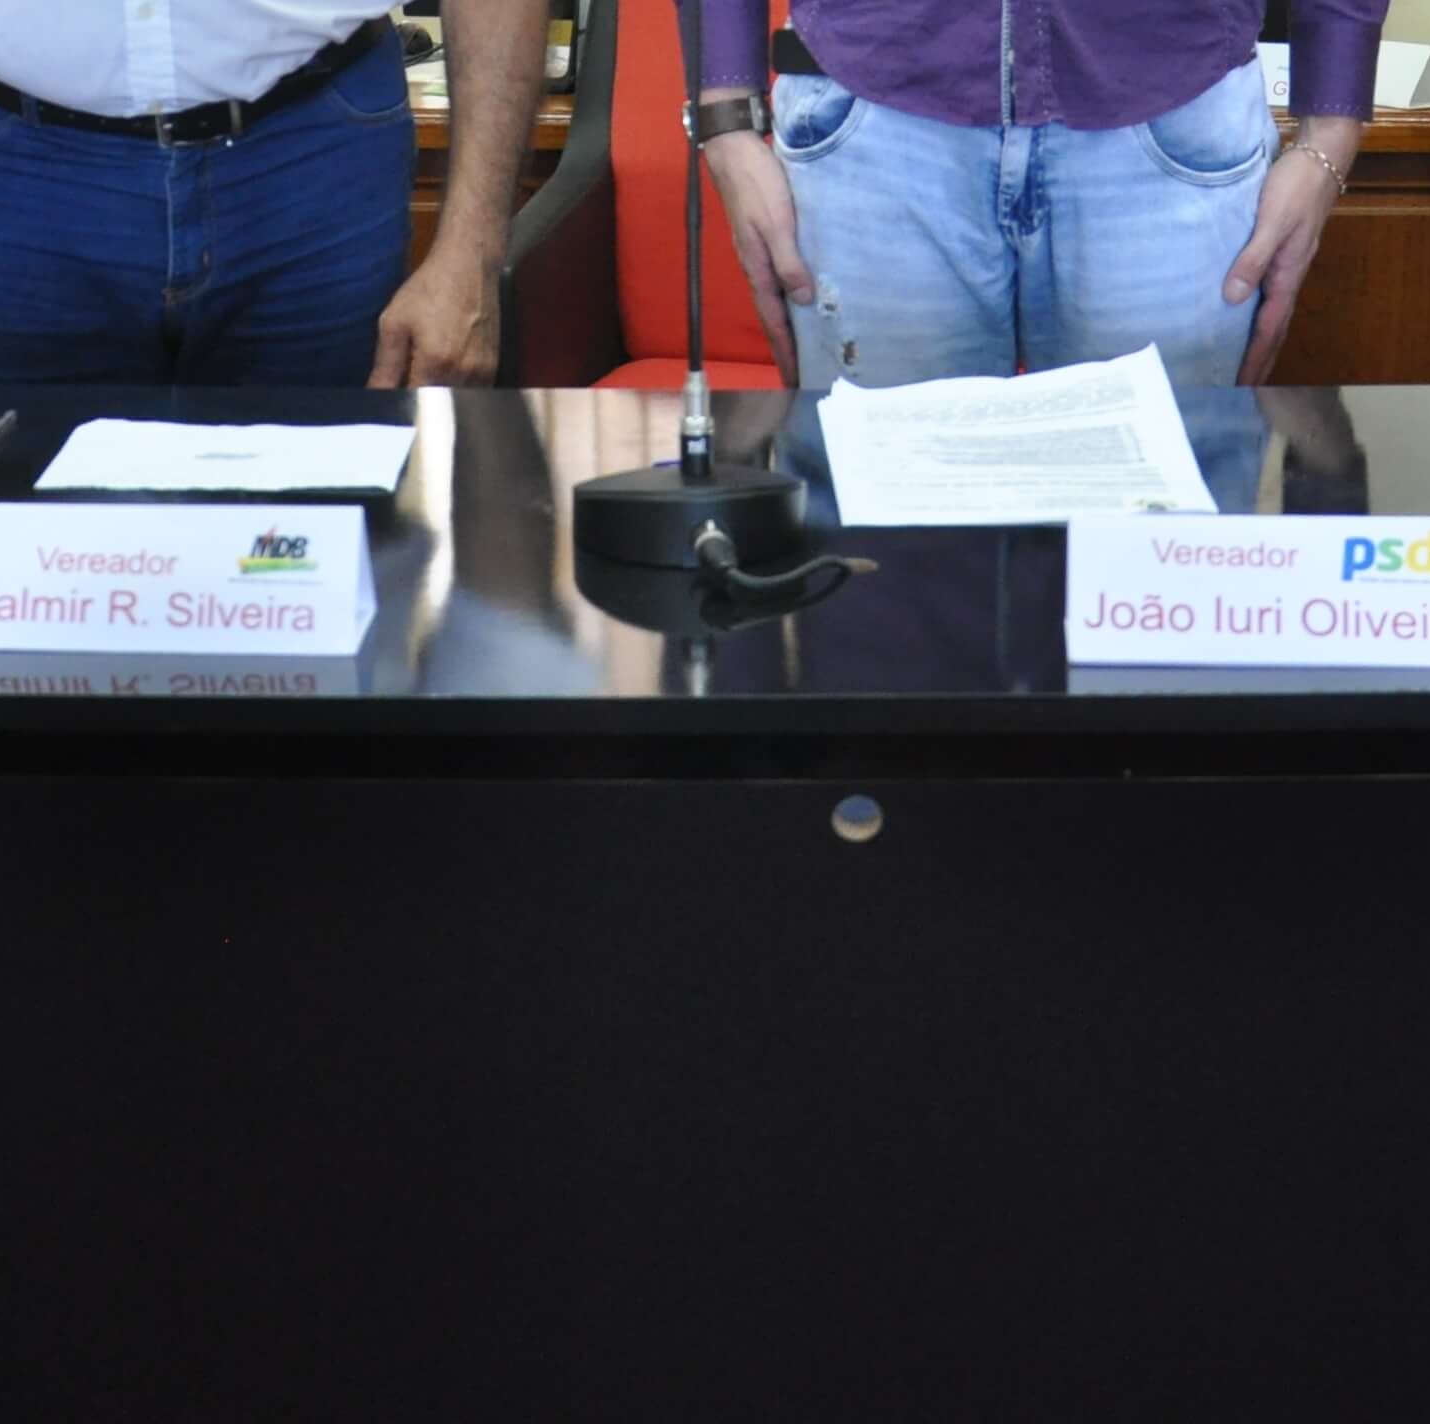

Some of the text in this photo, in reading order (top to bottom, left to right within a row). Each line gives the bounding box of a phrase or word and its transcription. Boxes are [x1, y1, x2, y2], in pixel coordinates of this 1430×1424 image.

[36, 545, 179, 576] Vereador
[249, 533, 309, 559] MDB
[1151, 537, 1299, 568] Vereador
[107, 589, 149, 627] R.
[164, 592, 315, 633] Silveira
[1084, 591, 1196, 636] João
[1216, 594, 1284, 636] Iuri
